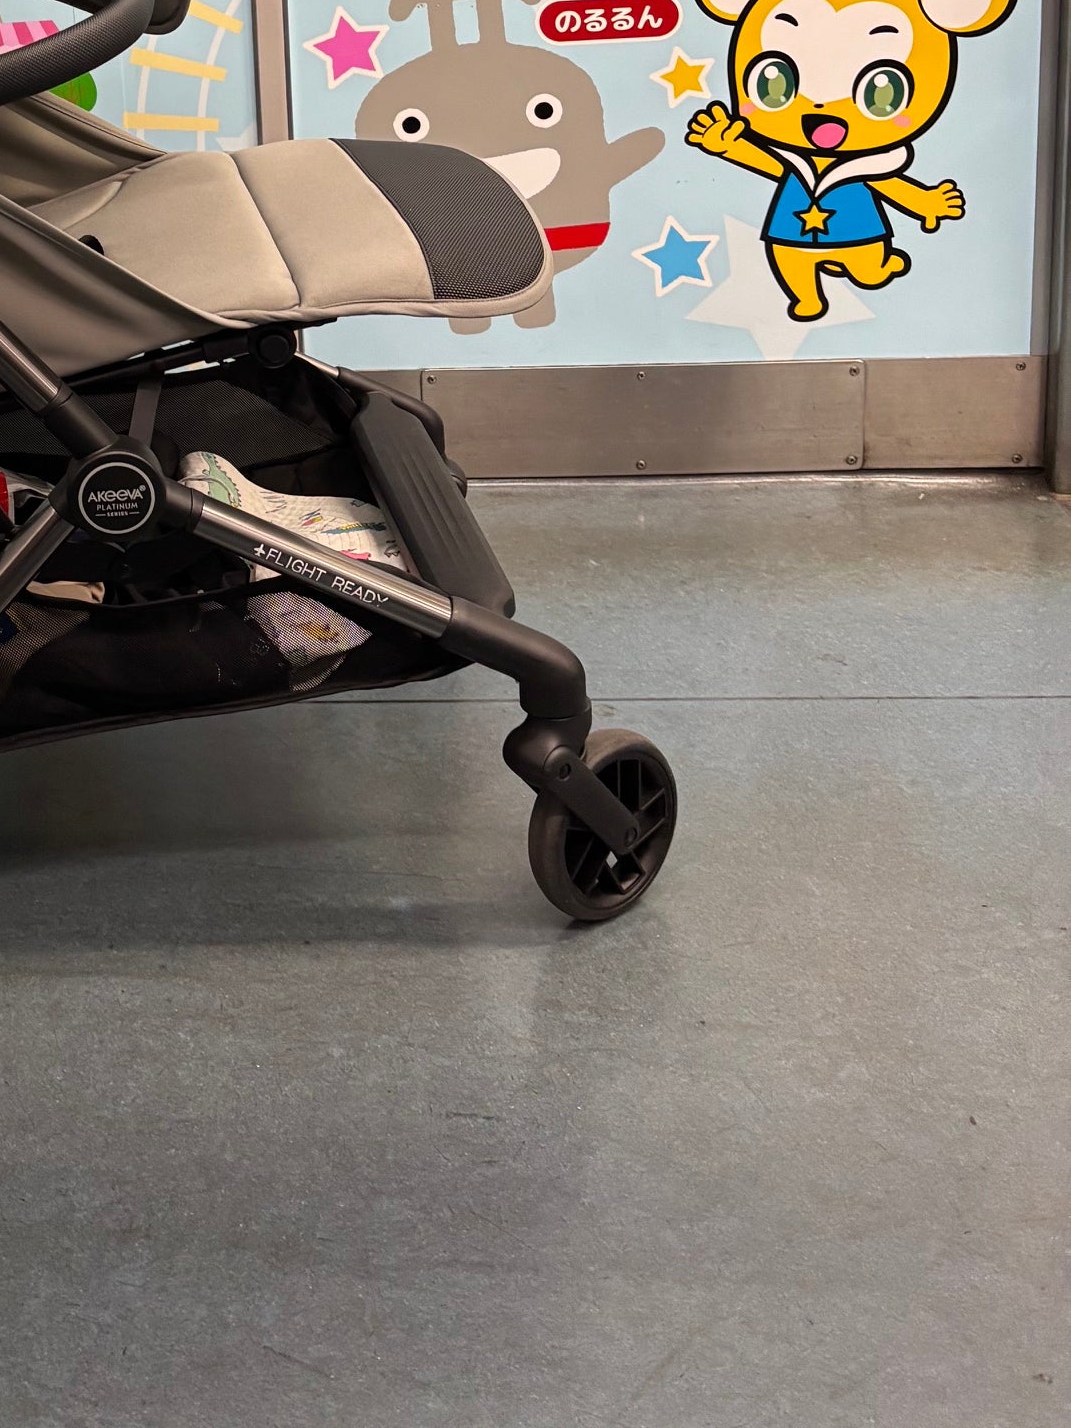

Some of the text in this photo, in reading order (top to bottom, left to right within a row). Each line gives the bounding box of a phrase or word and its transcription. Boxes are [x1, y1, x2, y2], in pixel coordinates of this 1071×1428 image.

[554, 4, 663, 34] のるるん
[96, 502, 138, 511] PLATINUM
[265, 548, 389, 607] FLIGHT READY
